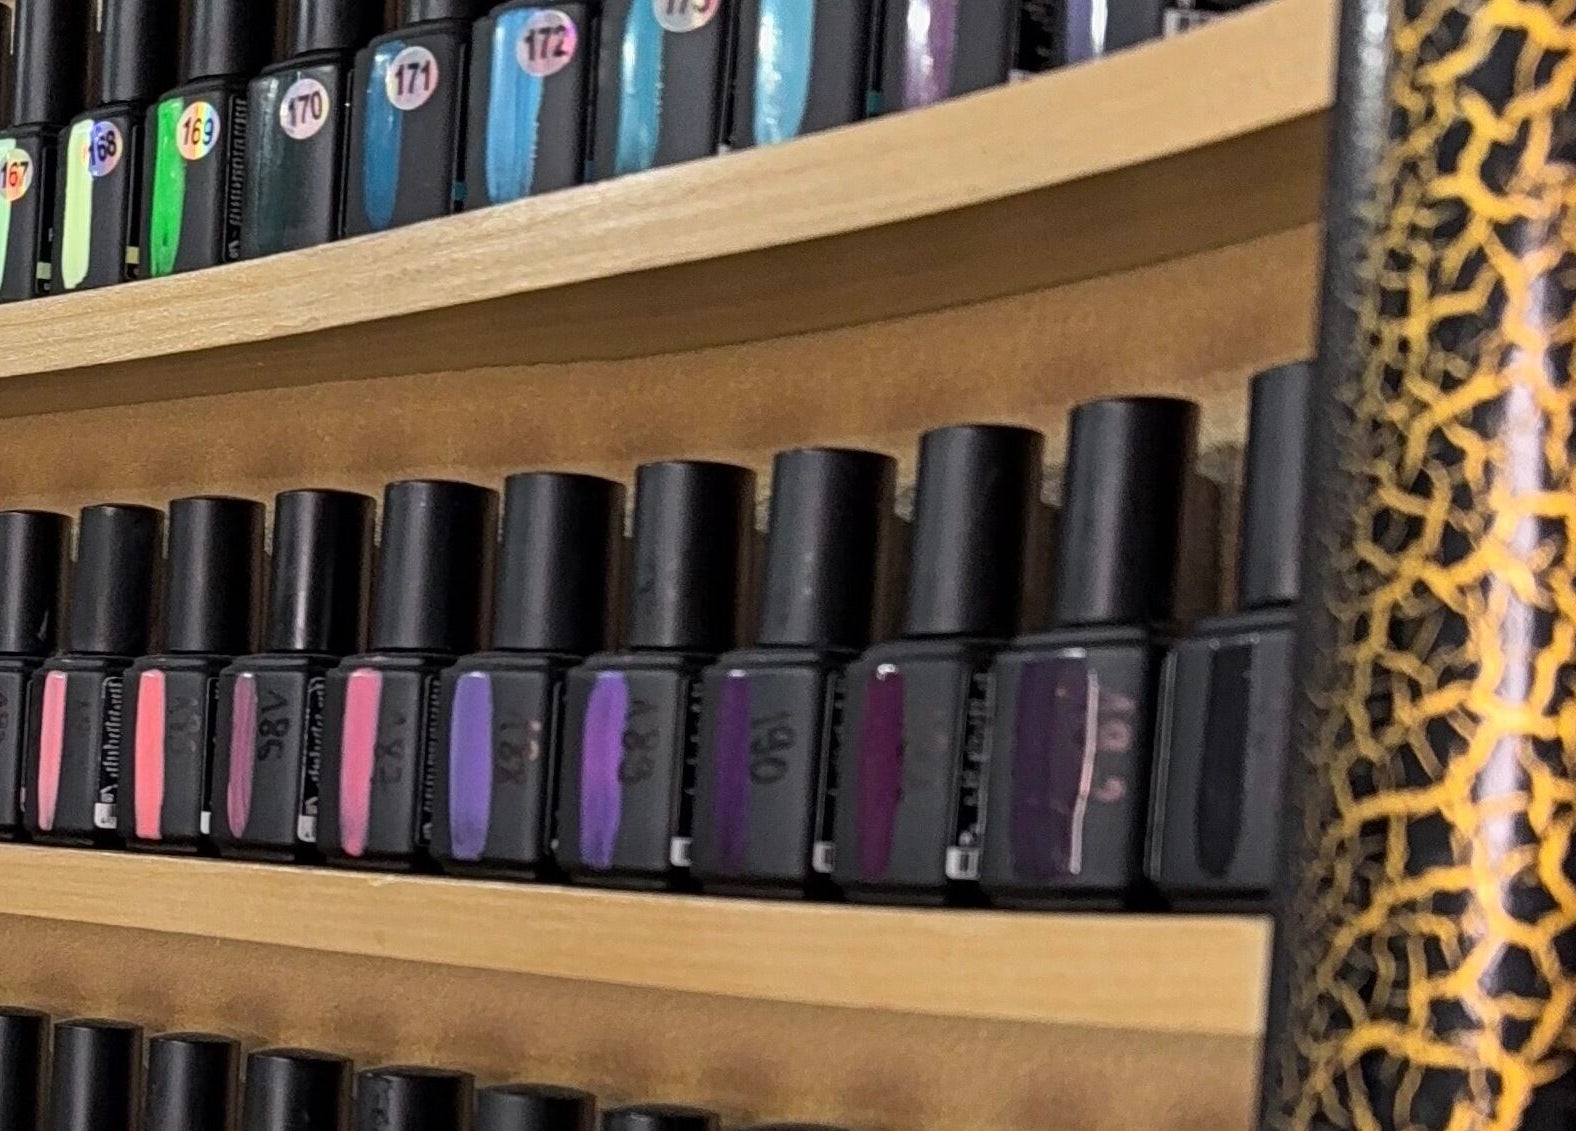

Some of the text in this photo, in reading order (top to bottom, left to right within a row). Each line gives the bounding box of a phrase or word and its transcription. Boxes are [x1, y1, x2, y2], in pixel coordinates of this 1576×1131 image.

[525, 25, 568, 61] 172
[395, 60, 431, 96] 171
[288, 90, 322, 127] 170
[88, 130, 117, 166] 168
[182, 117, 214, 146] 169
[0, 161, 29, 189] 167
[256, 692, 290, 762] 186
[749, 709, 795, 785] 190
